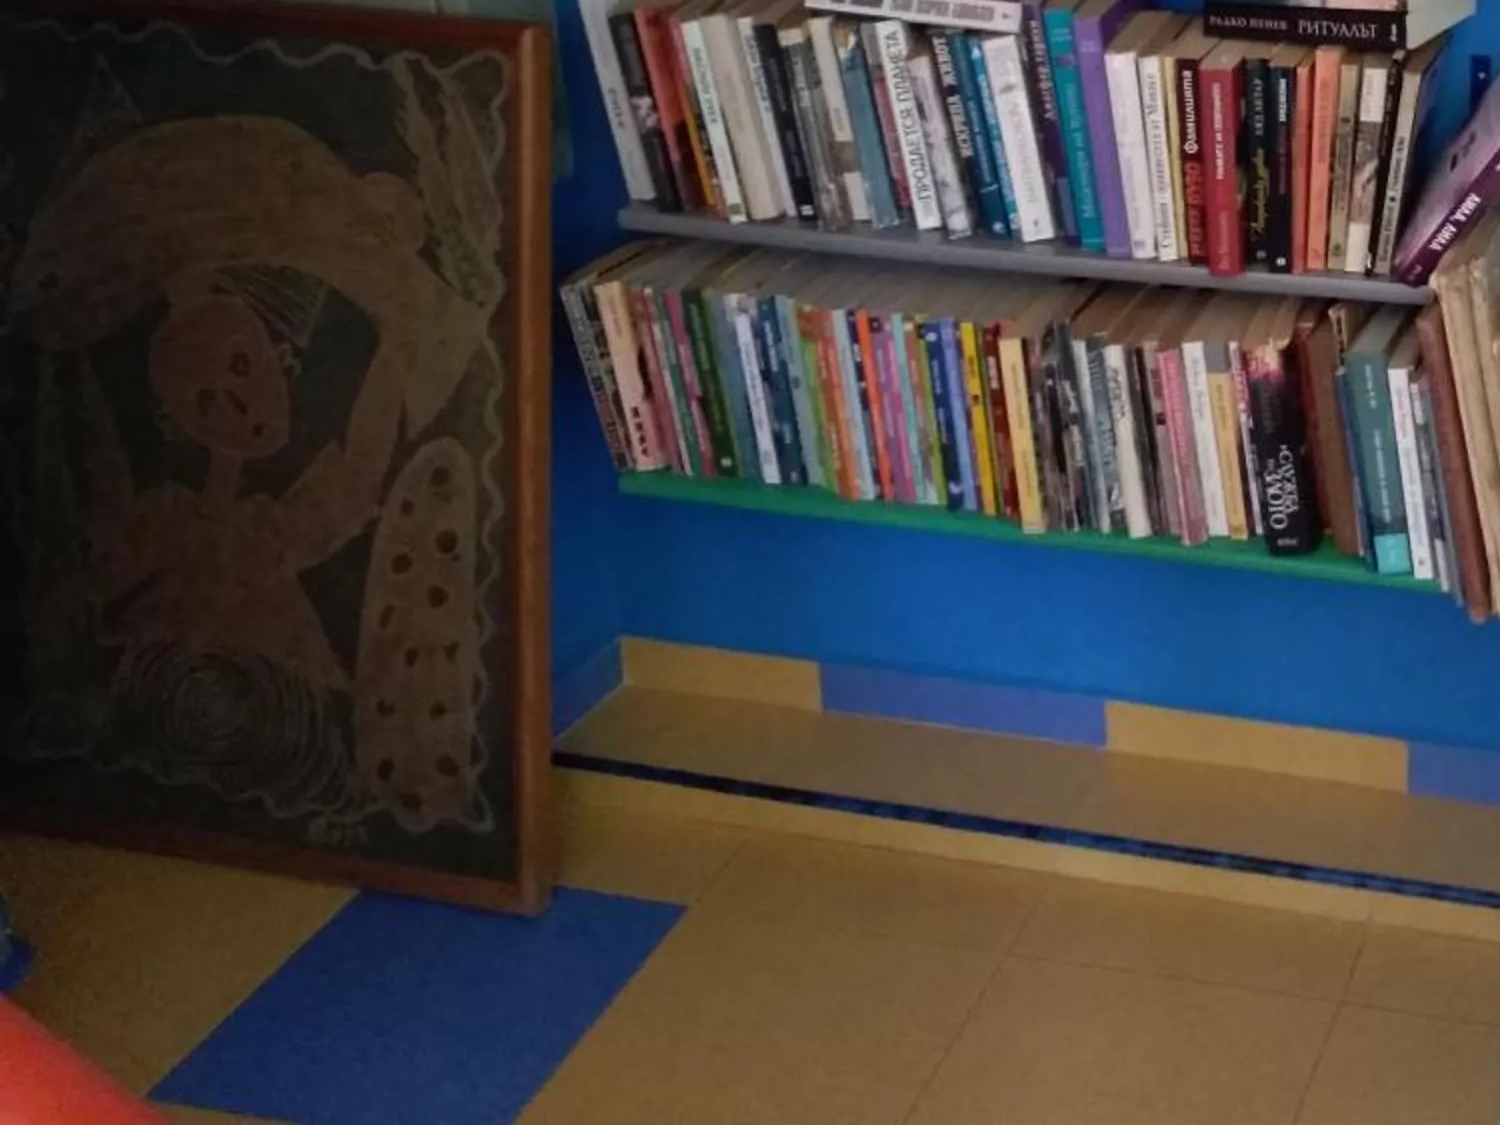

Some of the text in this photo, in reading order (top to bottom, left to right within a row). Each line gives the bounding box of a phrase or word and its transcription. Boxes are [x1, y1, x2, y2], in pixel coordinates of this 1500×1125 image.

[1209, 15, 1247, 27] РАДКО
[1297, 19, 1378, 38] РИТУАЛЪТ
[885, 30, 932, 201] ПРОДАЕТСЯ ПЛАНЕТА
[1183, 69, 1198, 154] Фамилията
